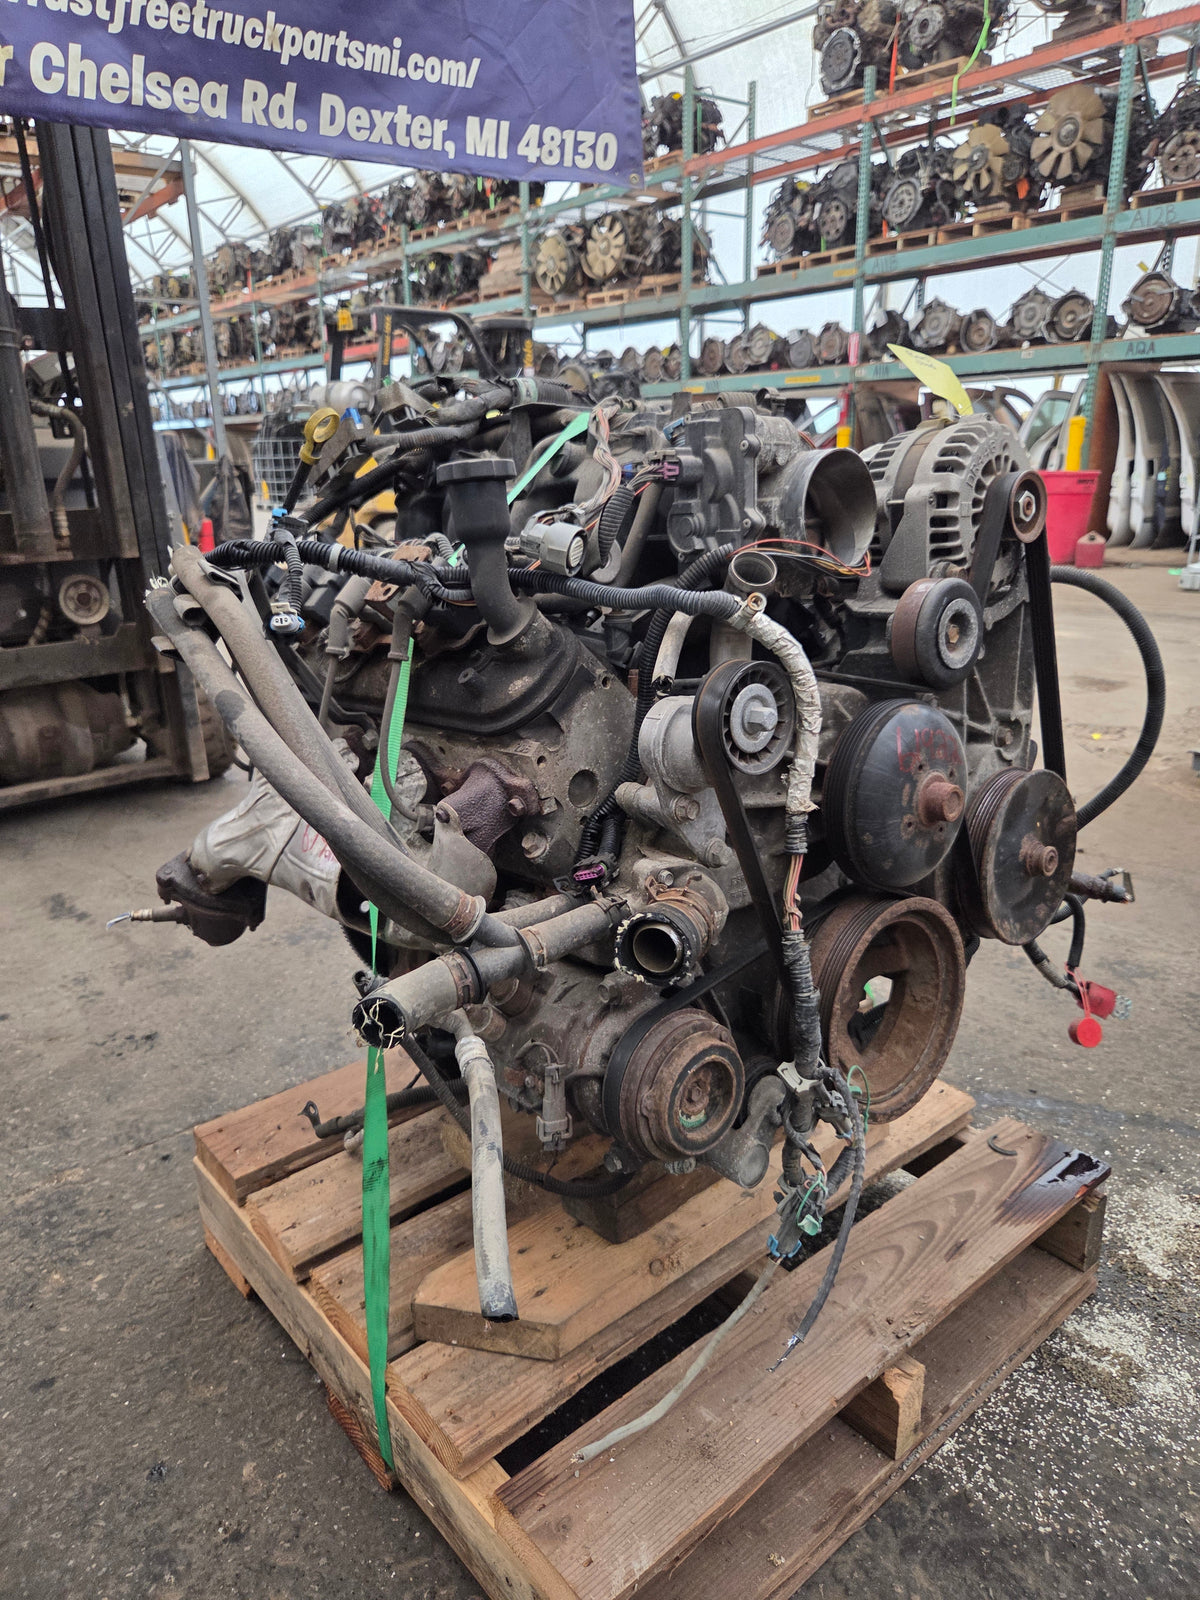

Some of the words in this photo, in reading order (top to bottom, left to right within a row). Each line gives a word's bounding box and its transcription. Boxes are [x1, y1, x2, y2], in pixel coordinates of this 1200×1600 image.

[8, 0, 481, 89] stfreetruckpartsmi.com/
[29, 41, 229, 119] Chelsea
[241, 78, 308, 133] Rd.
[319, 92, 456, 160] Dexter,
[465, 115, 511, 160] MI
[516, 123, 618, 171] 48130
